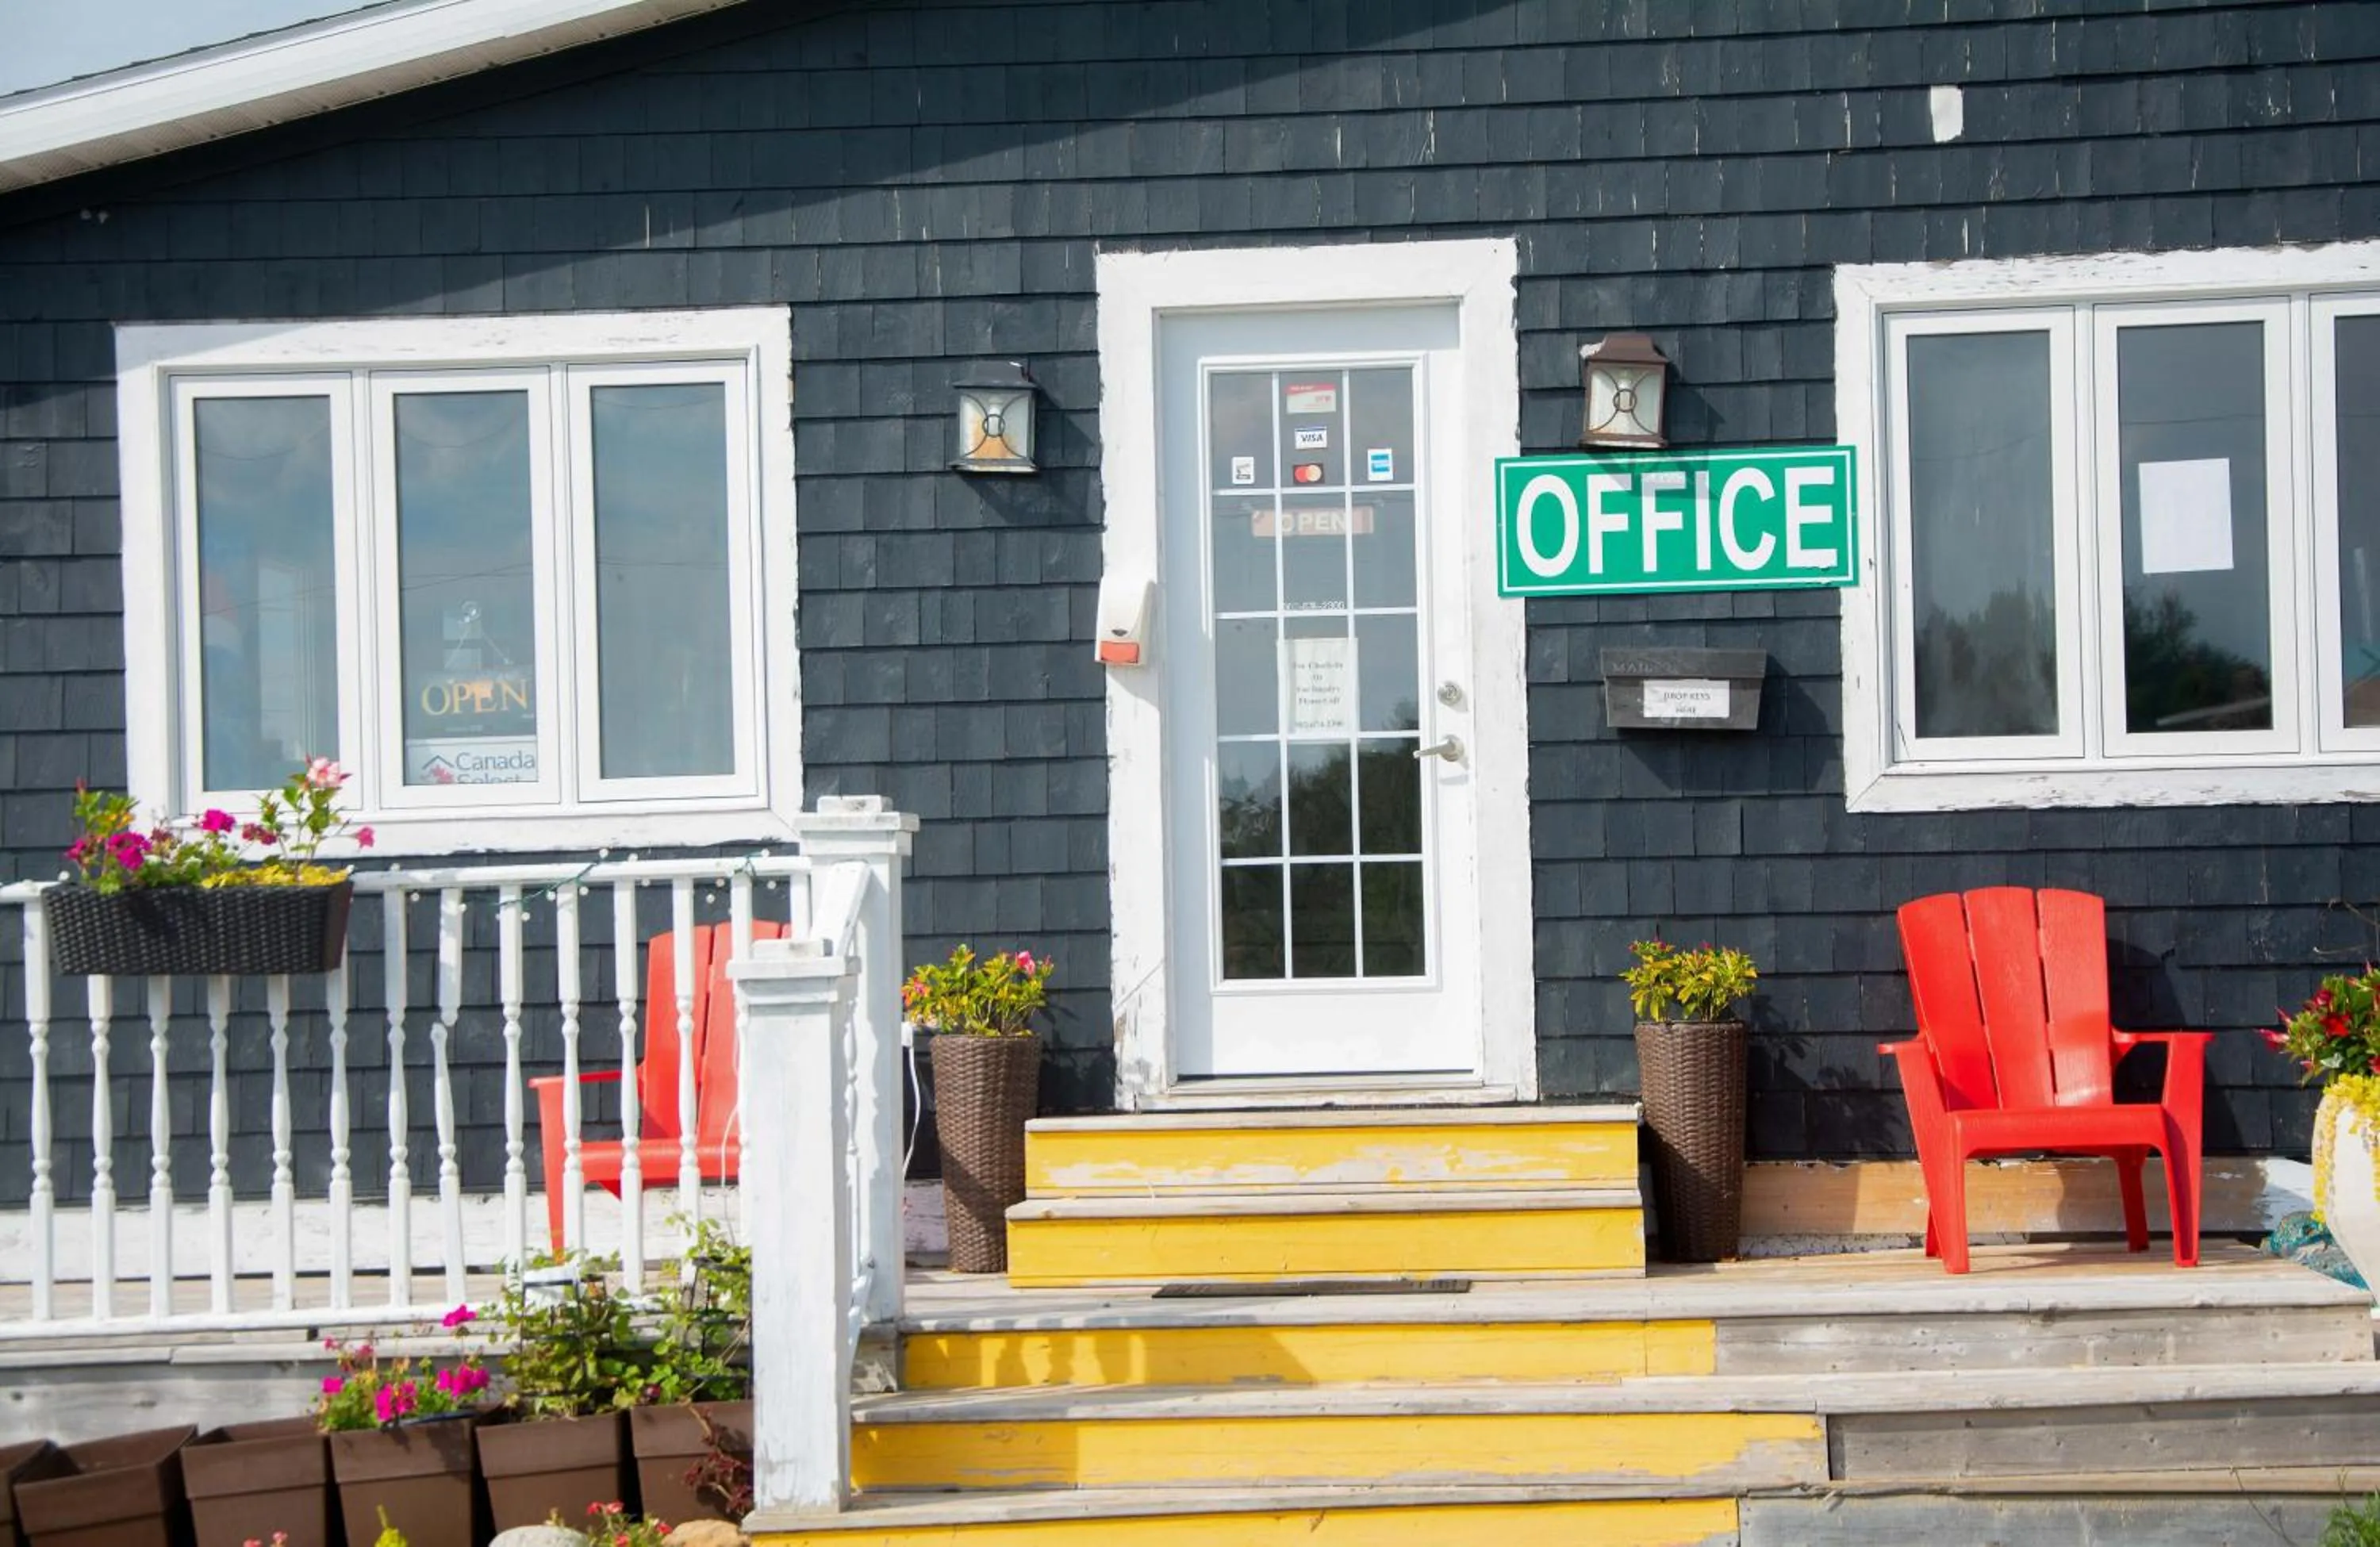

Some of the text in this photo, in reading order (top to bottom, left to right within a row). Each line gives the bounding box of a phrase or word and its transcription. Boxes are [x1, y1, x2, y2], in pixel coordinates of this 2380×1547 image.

[1300, 433, 1323, 442] VISA
[1281, 511, 1347, 533] OPEN
[1516, 466, 1838, 578] OFFICE
[421, 678, 529, 716] OPEN
[1689, 692, 1710, 701] KEYS
[455, 750, 536, 771] Canada
